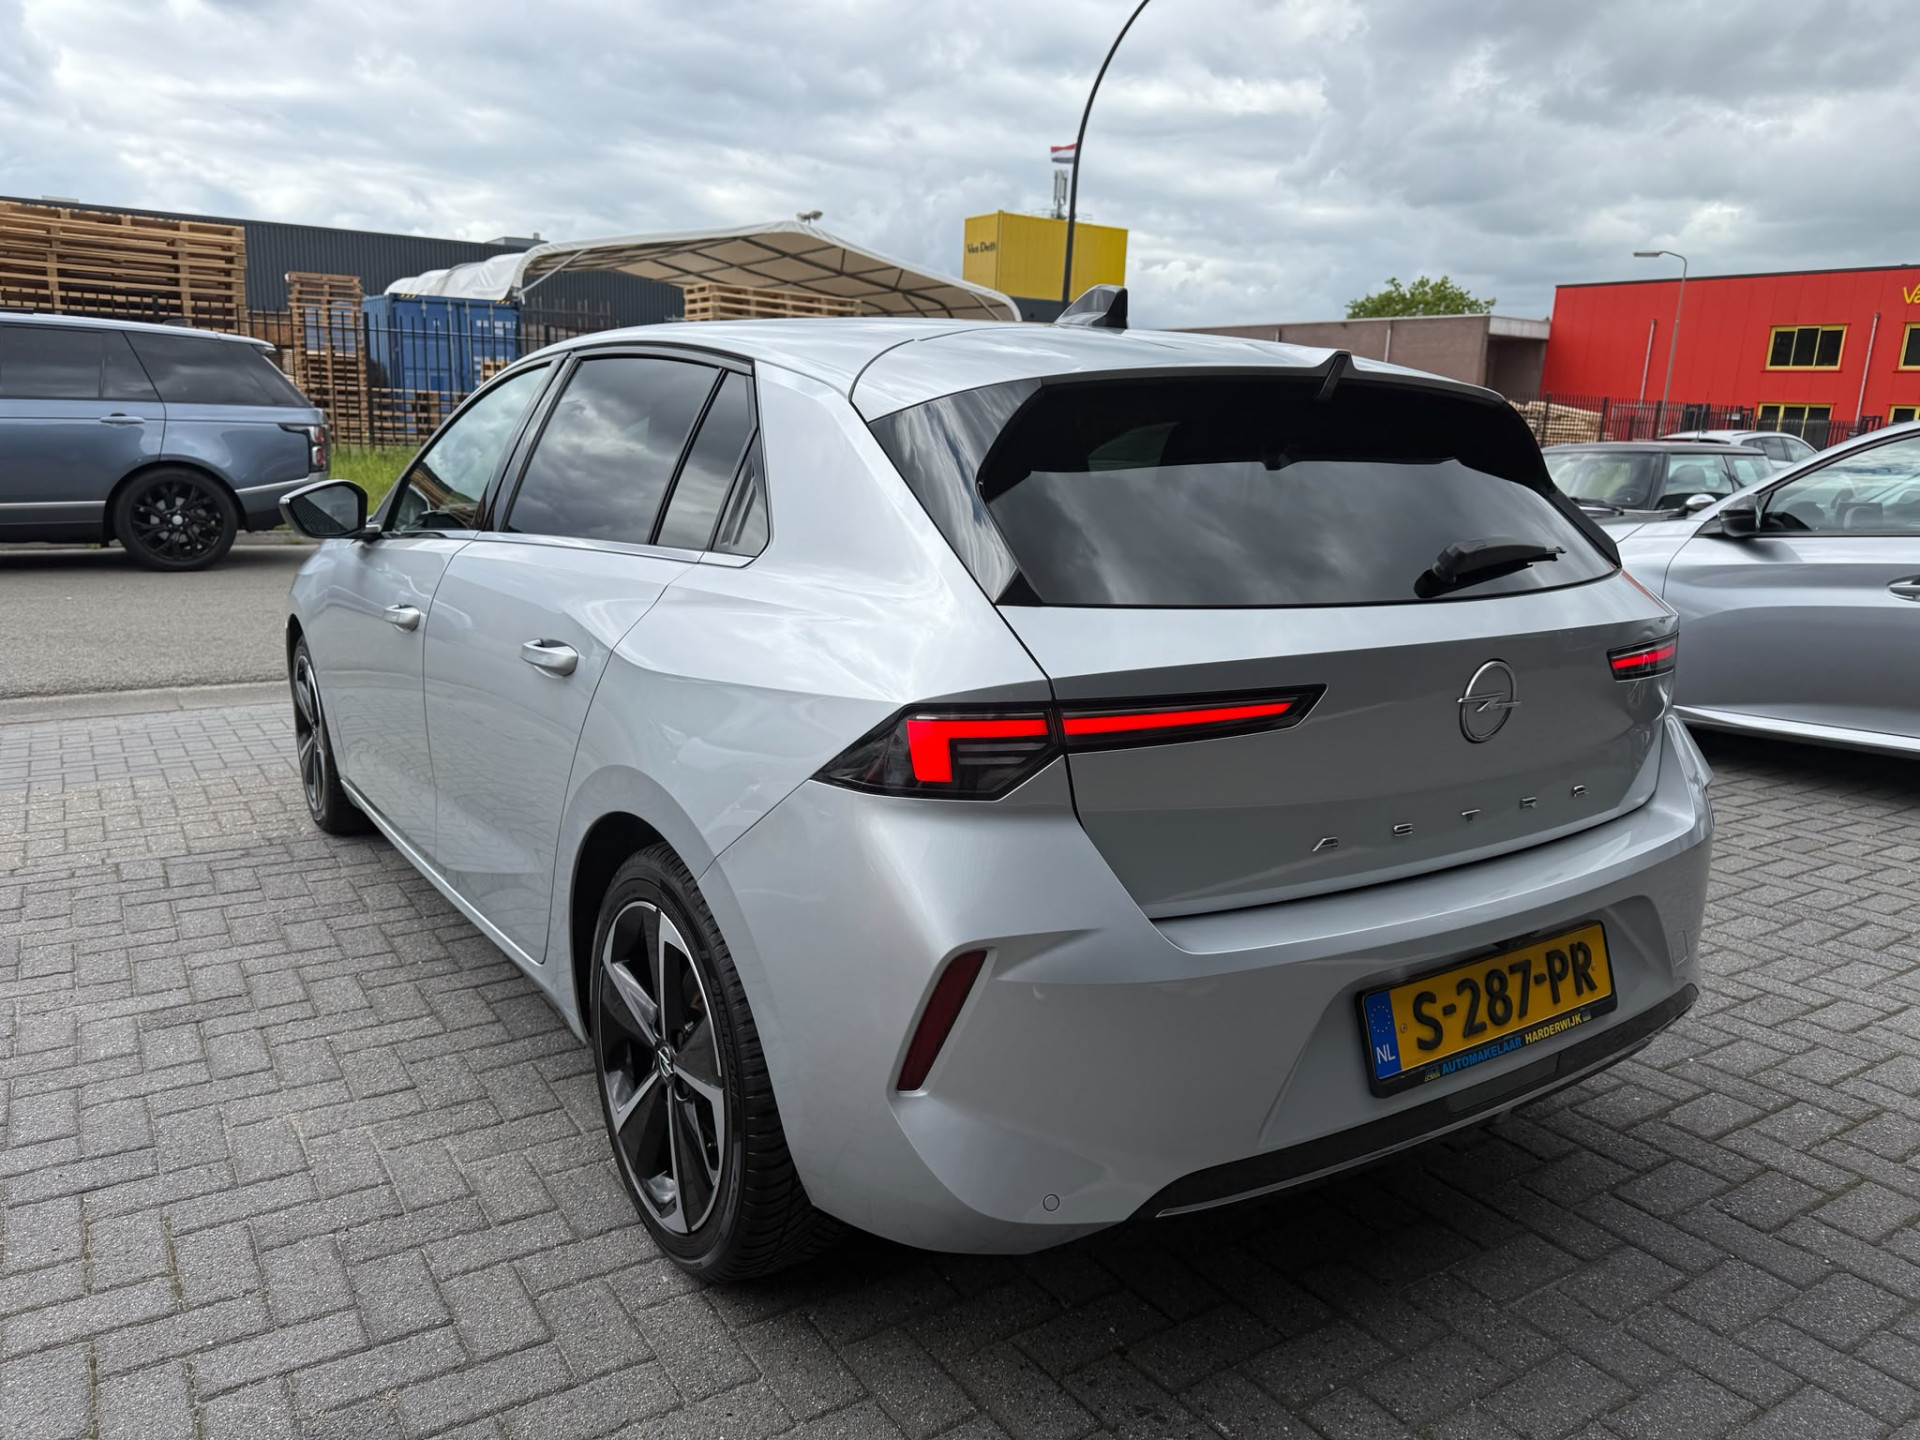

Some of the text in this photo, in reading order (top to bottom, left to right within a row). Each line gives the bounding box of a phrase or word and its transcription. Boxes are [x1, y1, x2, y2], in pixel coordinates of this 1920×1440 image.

[1312, 784, 1590, 852] ASTRA
[1412, 941, 1598, 1051] S-287-PR
[1376, 1043, 1396, 1065] NL
[1441, 1014, 1583, 1075] AUTOMAKELAAR HARDERWIJK
